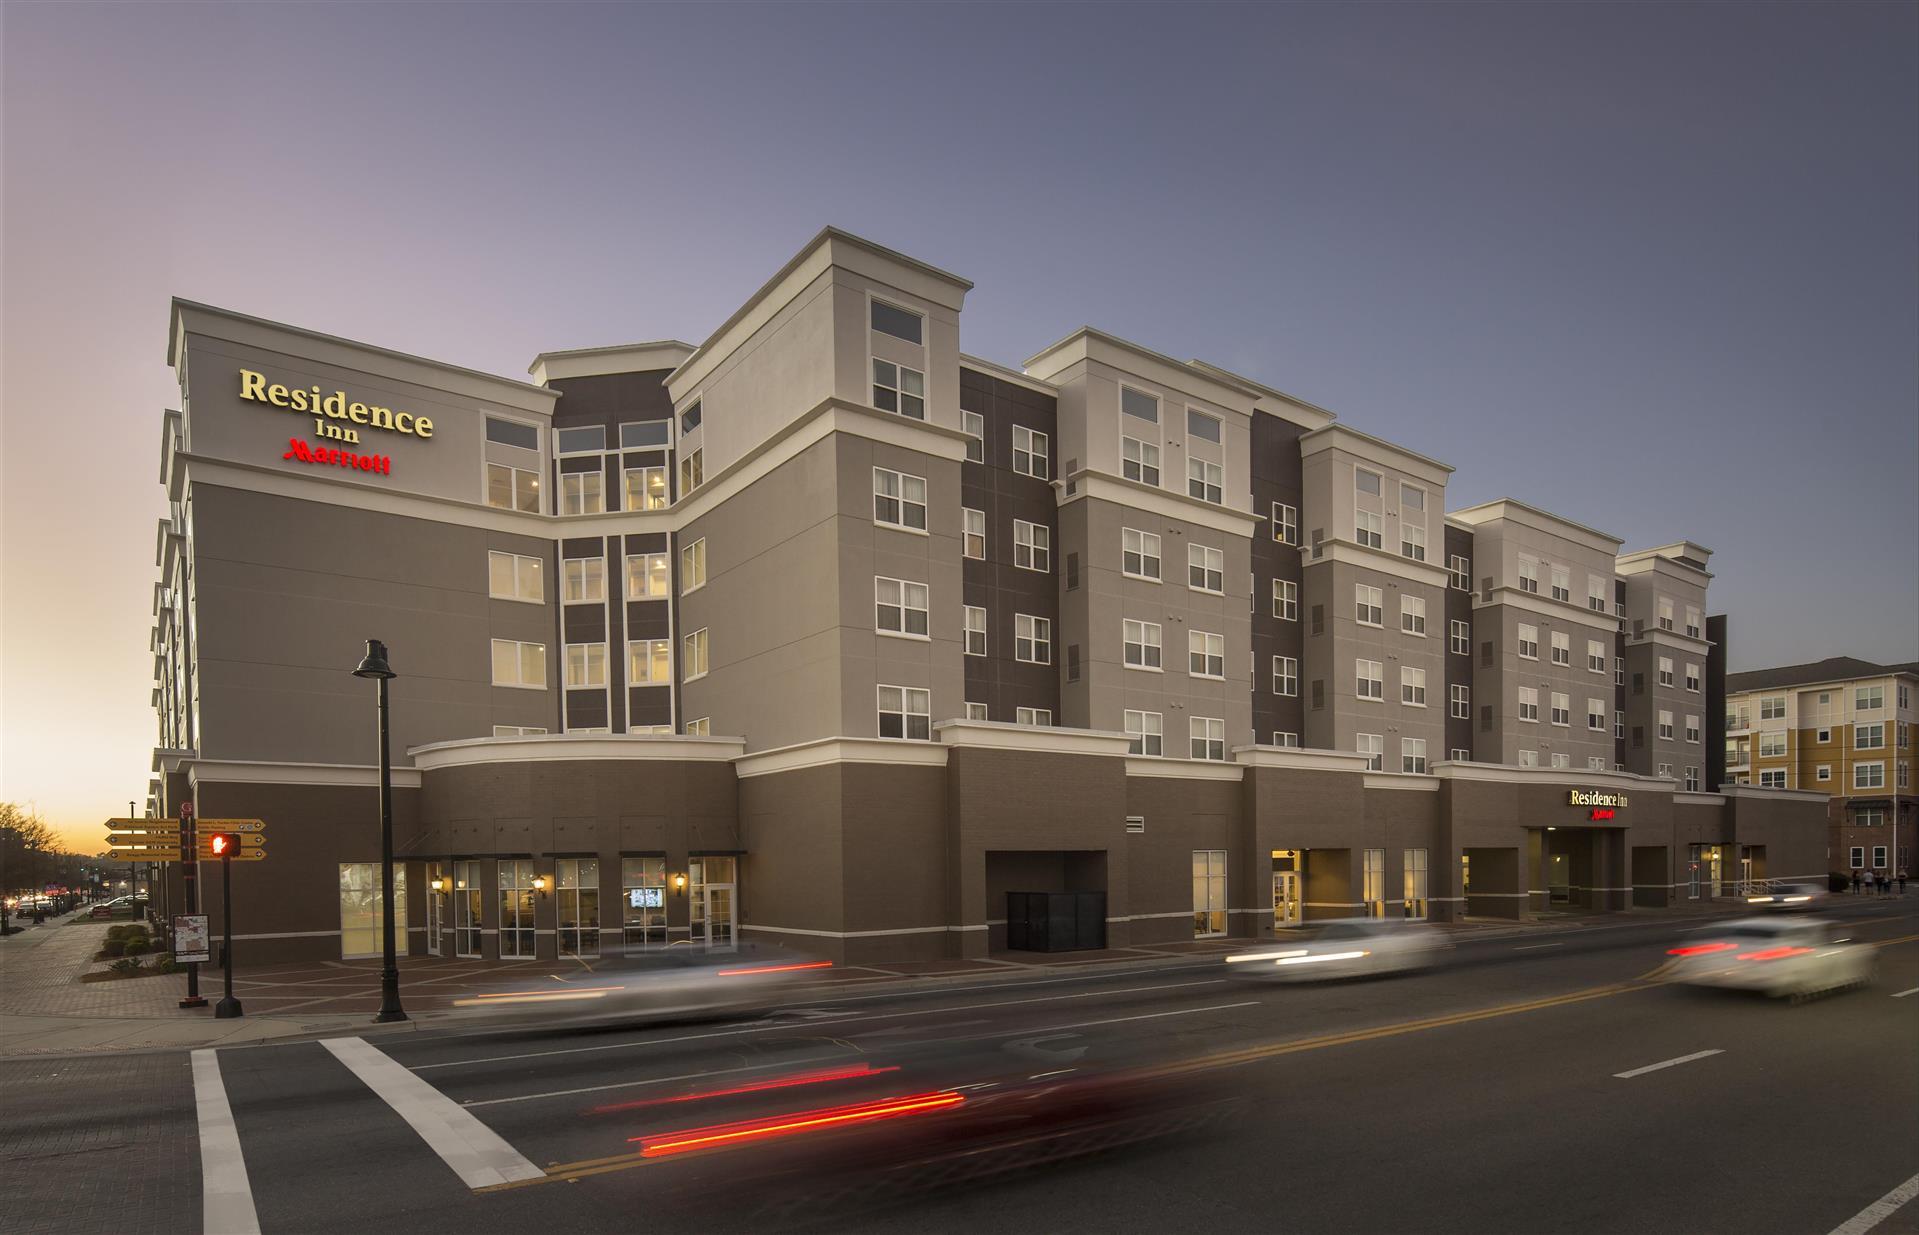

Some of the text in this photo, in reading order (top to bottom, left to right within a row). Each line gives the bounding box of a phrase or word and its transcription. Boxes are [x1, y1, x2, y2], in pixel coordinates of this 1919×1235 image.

[239, 368, 434, 438] Residence
[314, 418, 360, 444] Inn
[283, 437, 391, 475] Marriott
[1571, 790, 1617, 807] Residence
